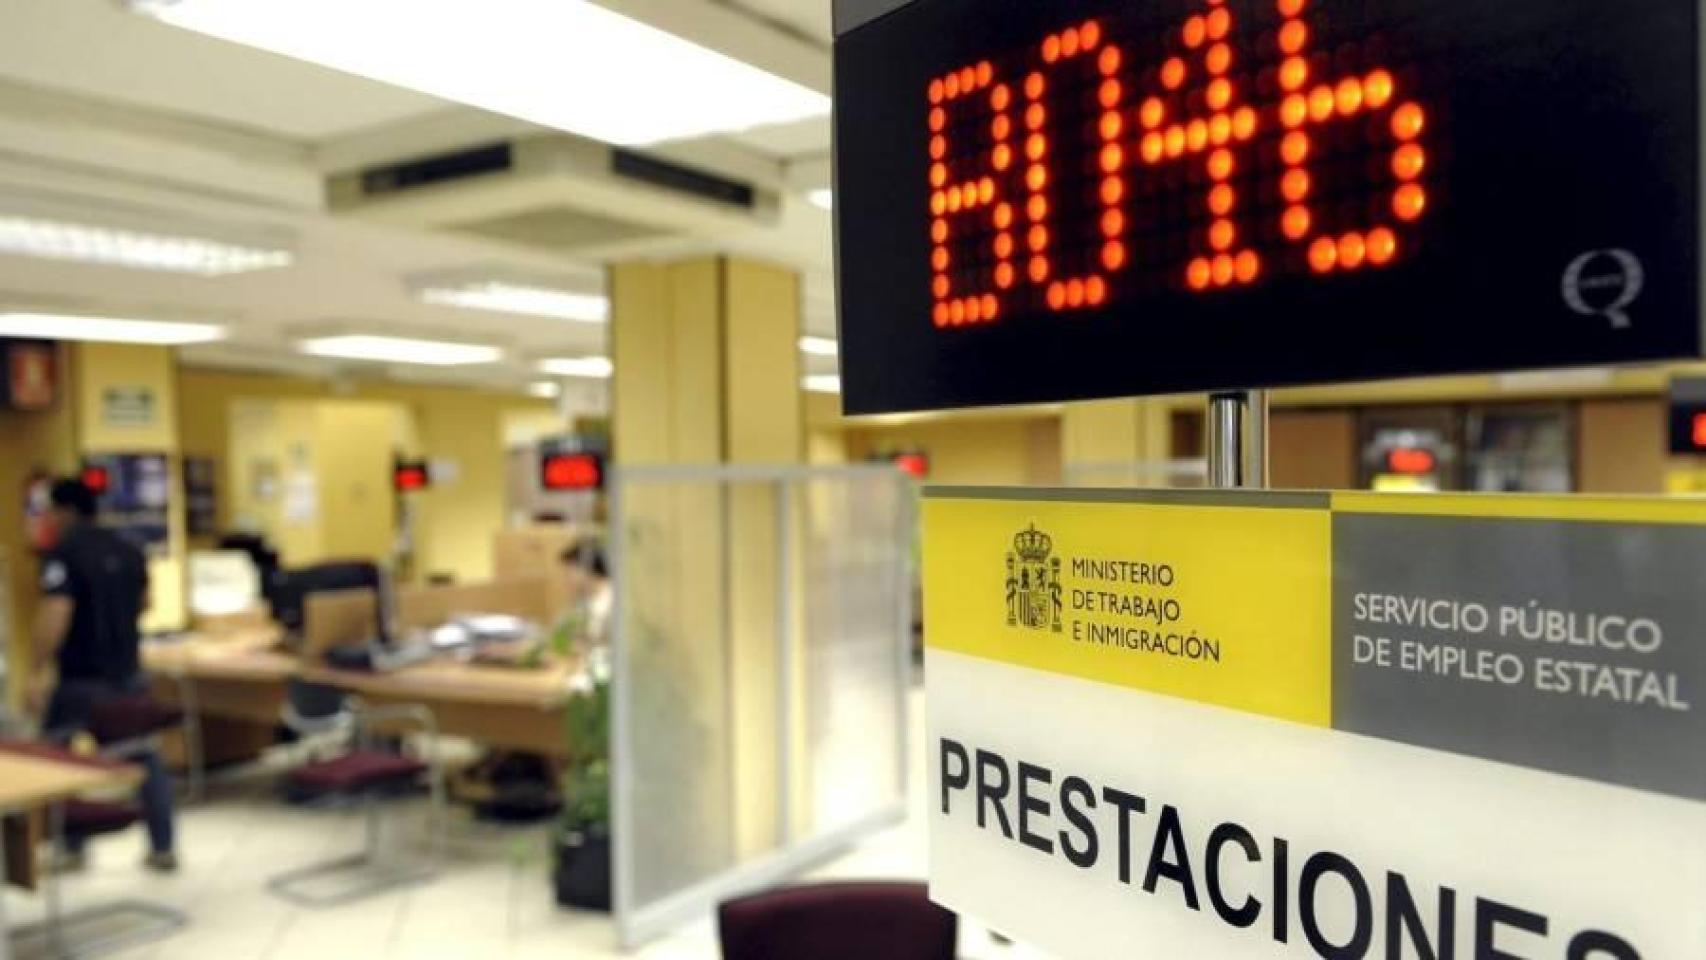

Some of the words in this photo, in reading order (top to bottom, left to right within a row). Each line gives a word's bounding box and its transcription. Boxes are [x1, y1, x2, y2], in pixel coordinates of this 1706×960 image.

[927, 0, 1426, 327] B046
[1072, 557, 1174, 587] MINISTERIO
[1072, 589, 1095, 612] DE
[1096, 591, 1181, 626] TRABAJO
[1354, 592, 1489, 633] SERVICIO
[1499, 599, 1662, 654] PÚBLICO
[1072, 620, 1081, 641] E
[1087, 622, 1220, 663] INMIGRACIÓN
[1353, 635, 1392, 667] DE
[1400, 641, 1525, 684] EMPLEO
[1534, 657, 1690, 711] ESTATAL
[939, 736, 1645, 960] PRESTACIONE
